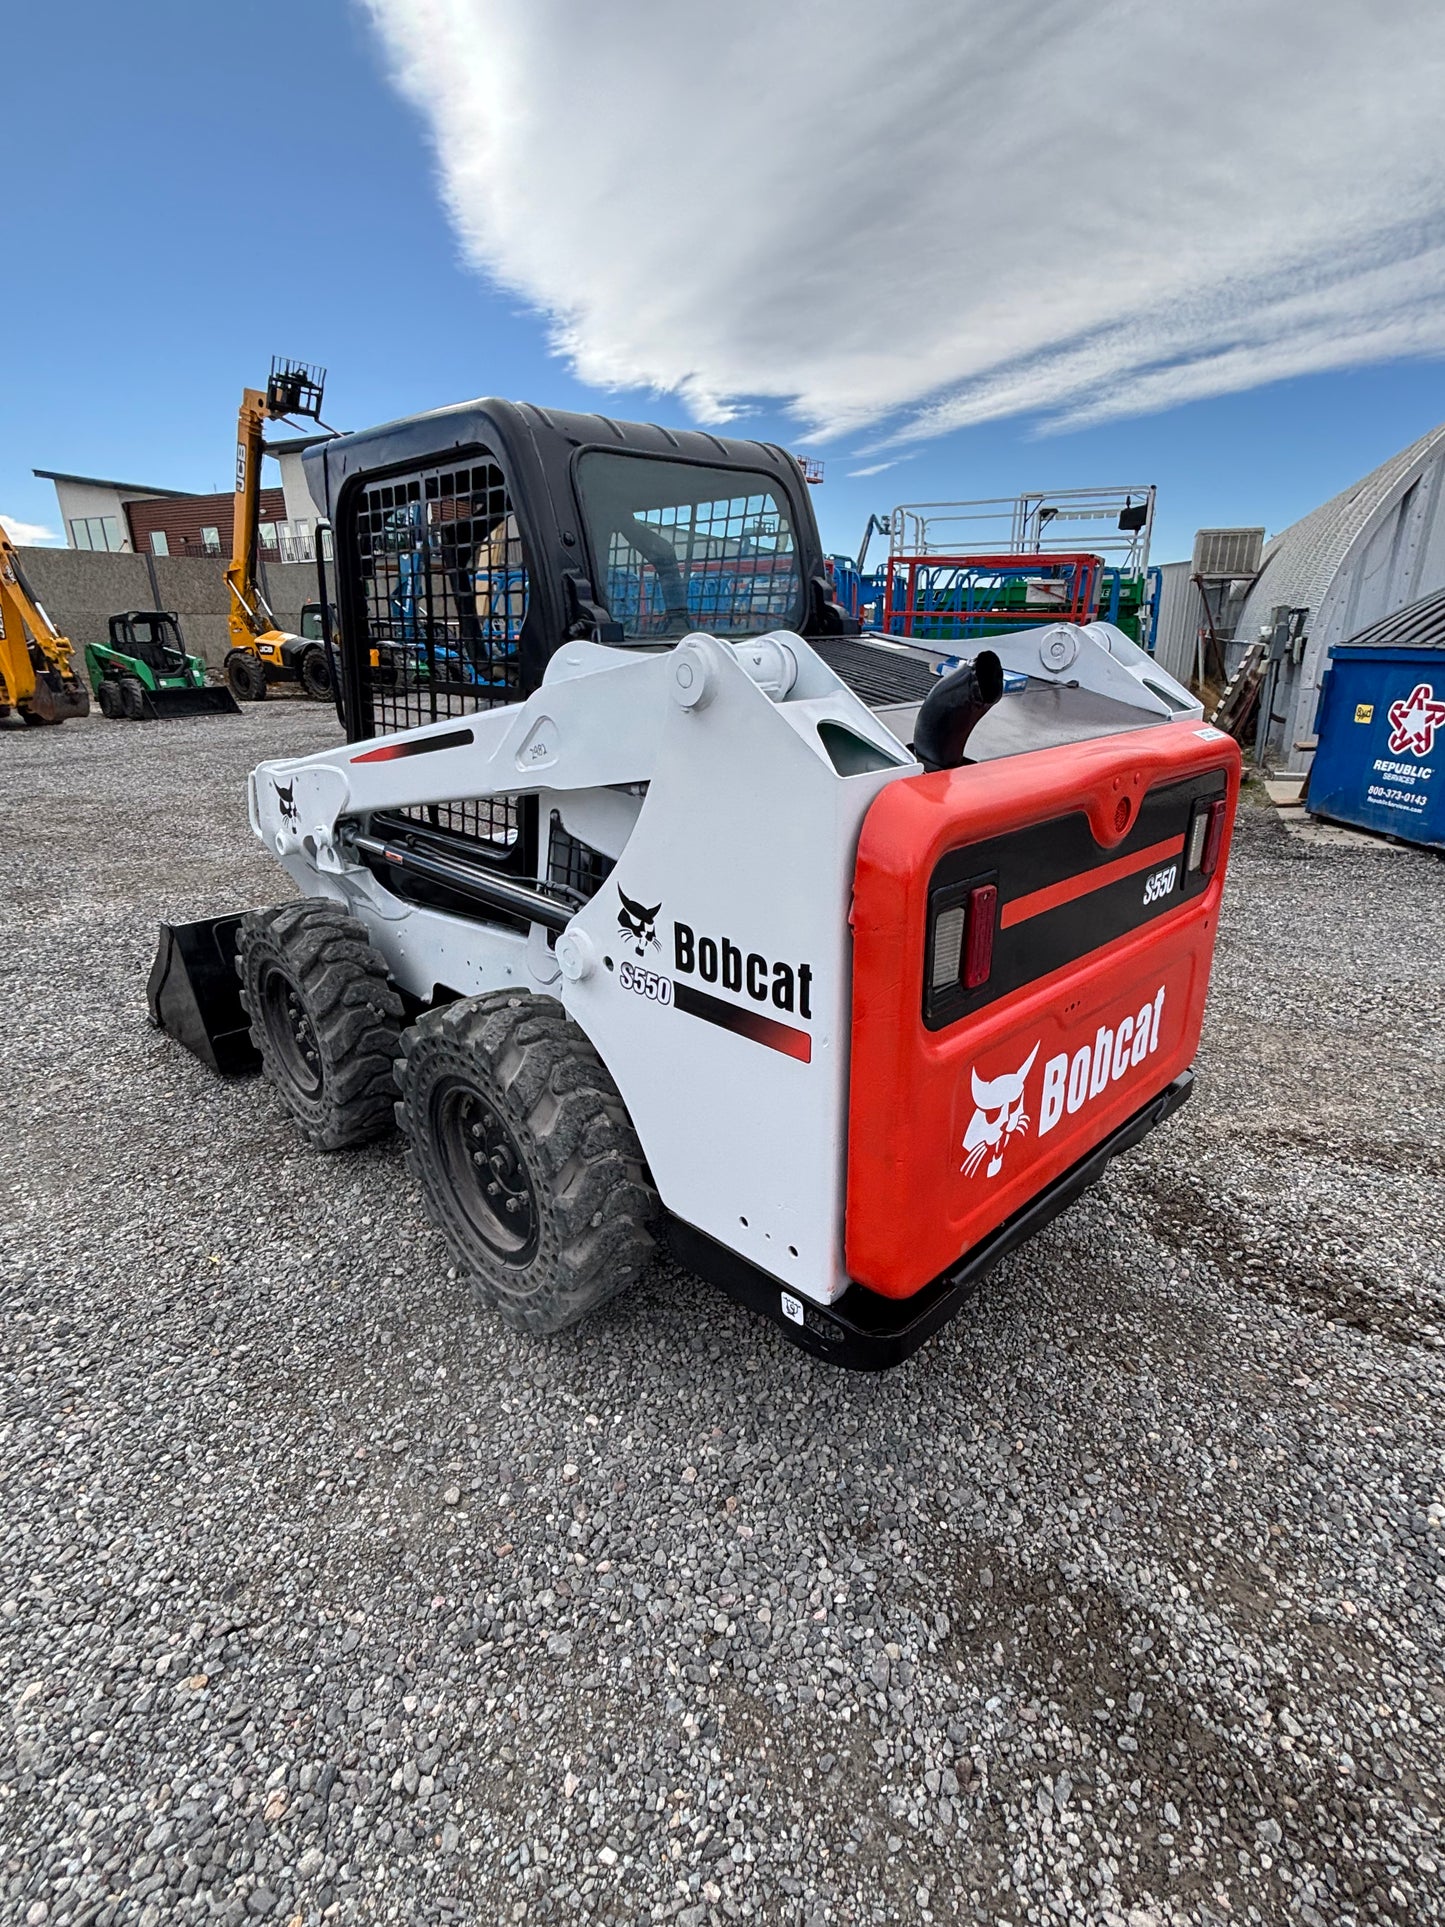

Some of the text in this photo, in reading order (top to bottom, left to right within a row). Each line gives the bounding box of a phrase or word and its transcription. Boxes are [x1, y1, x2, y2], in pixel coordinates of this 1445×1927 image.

[237, 444, 246, 493] JCB
[259, 645, 273, 653] JCB
[1372, 760, 1432, 779] REPUBLIC
[1383, 772, 1415, 785] SERVICES
[1368, 785, 1427, 806] 800-373-0143
[1142, 864, 1177, 905] S550
[619, 961, 672, 1006] S550
[673, 920, 813, 1020] Bobcat
[1038, 985, 1166, 1138] Bobcat
